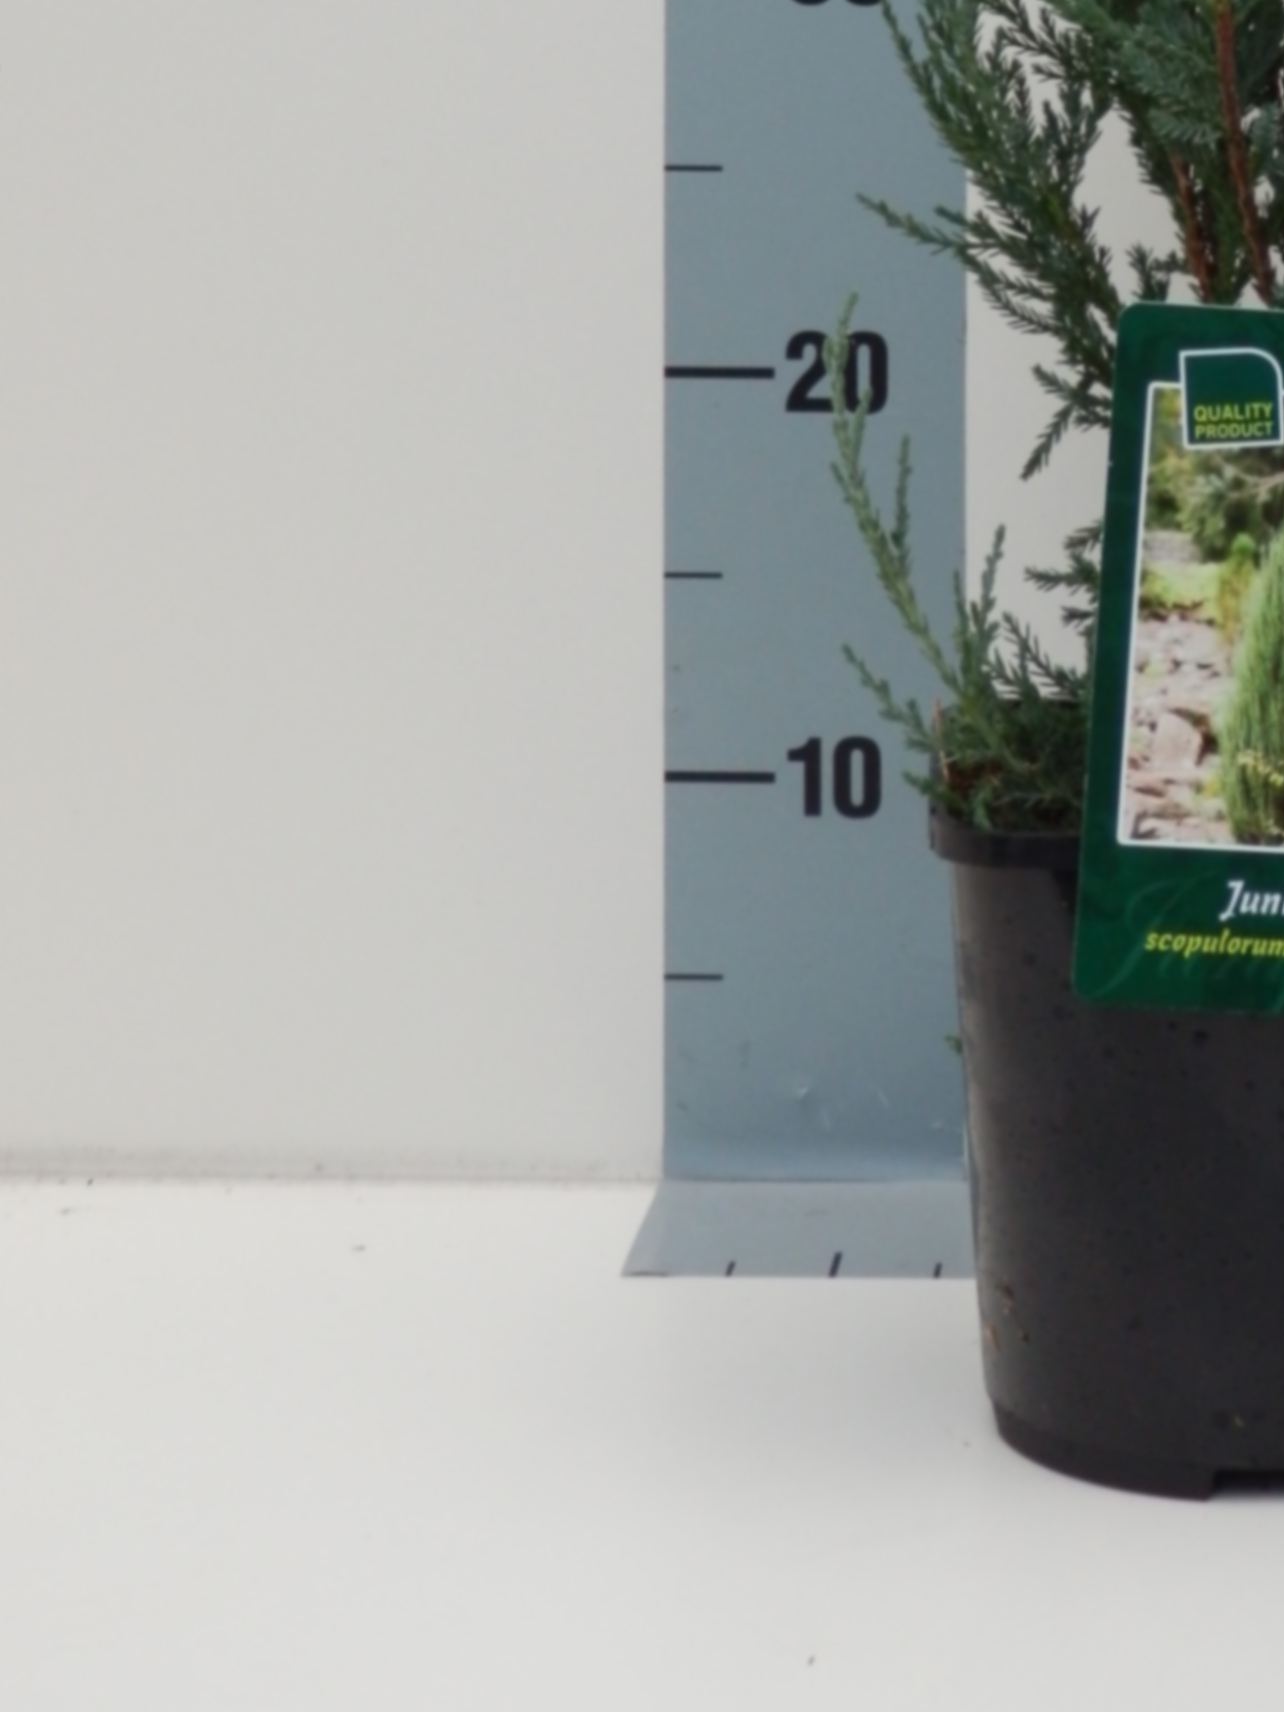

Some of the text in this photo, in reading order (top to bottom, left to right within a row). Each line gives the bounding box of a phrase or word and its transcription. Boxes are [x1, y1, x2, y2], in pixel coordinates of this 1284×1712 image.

[784, 329, 889, 415] 20
[1193, 401, 1273, 422] QUALITY
[1194, 420, 1273, 440] PRODUCT
[786, 734, 883, 821] 10
